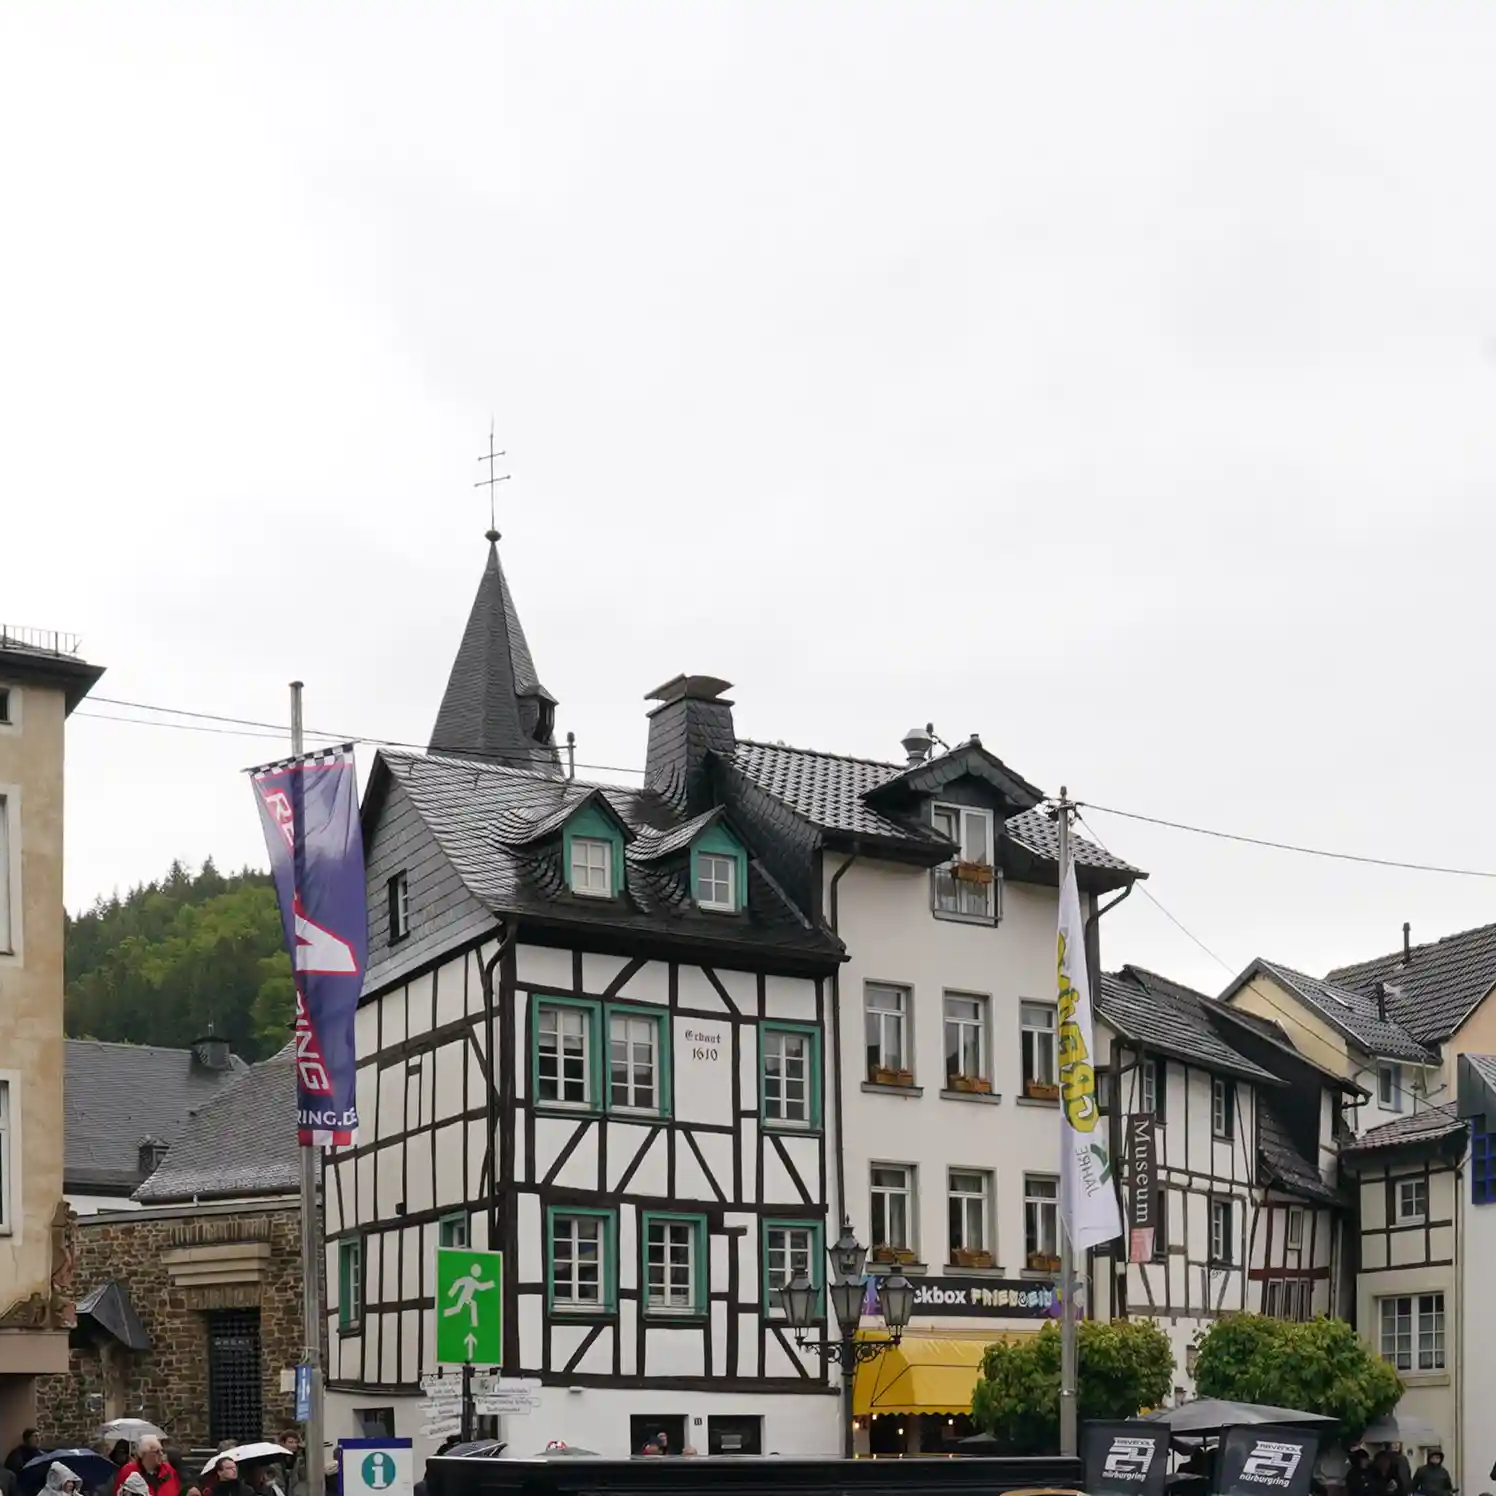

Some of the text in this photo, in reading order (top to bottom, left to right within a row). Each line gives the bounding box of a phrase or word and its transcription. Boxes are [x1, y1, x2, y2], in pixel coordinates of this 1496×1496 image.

[692, 1047, 719, 1061] 1610
[1134, 1119, 1151, 1223] Museum
[1239, 1473, 1291, 1488] nürburgring
